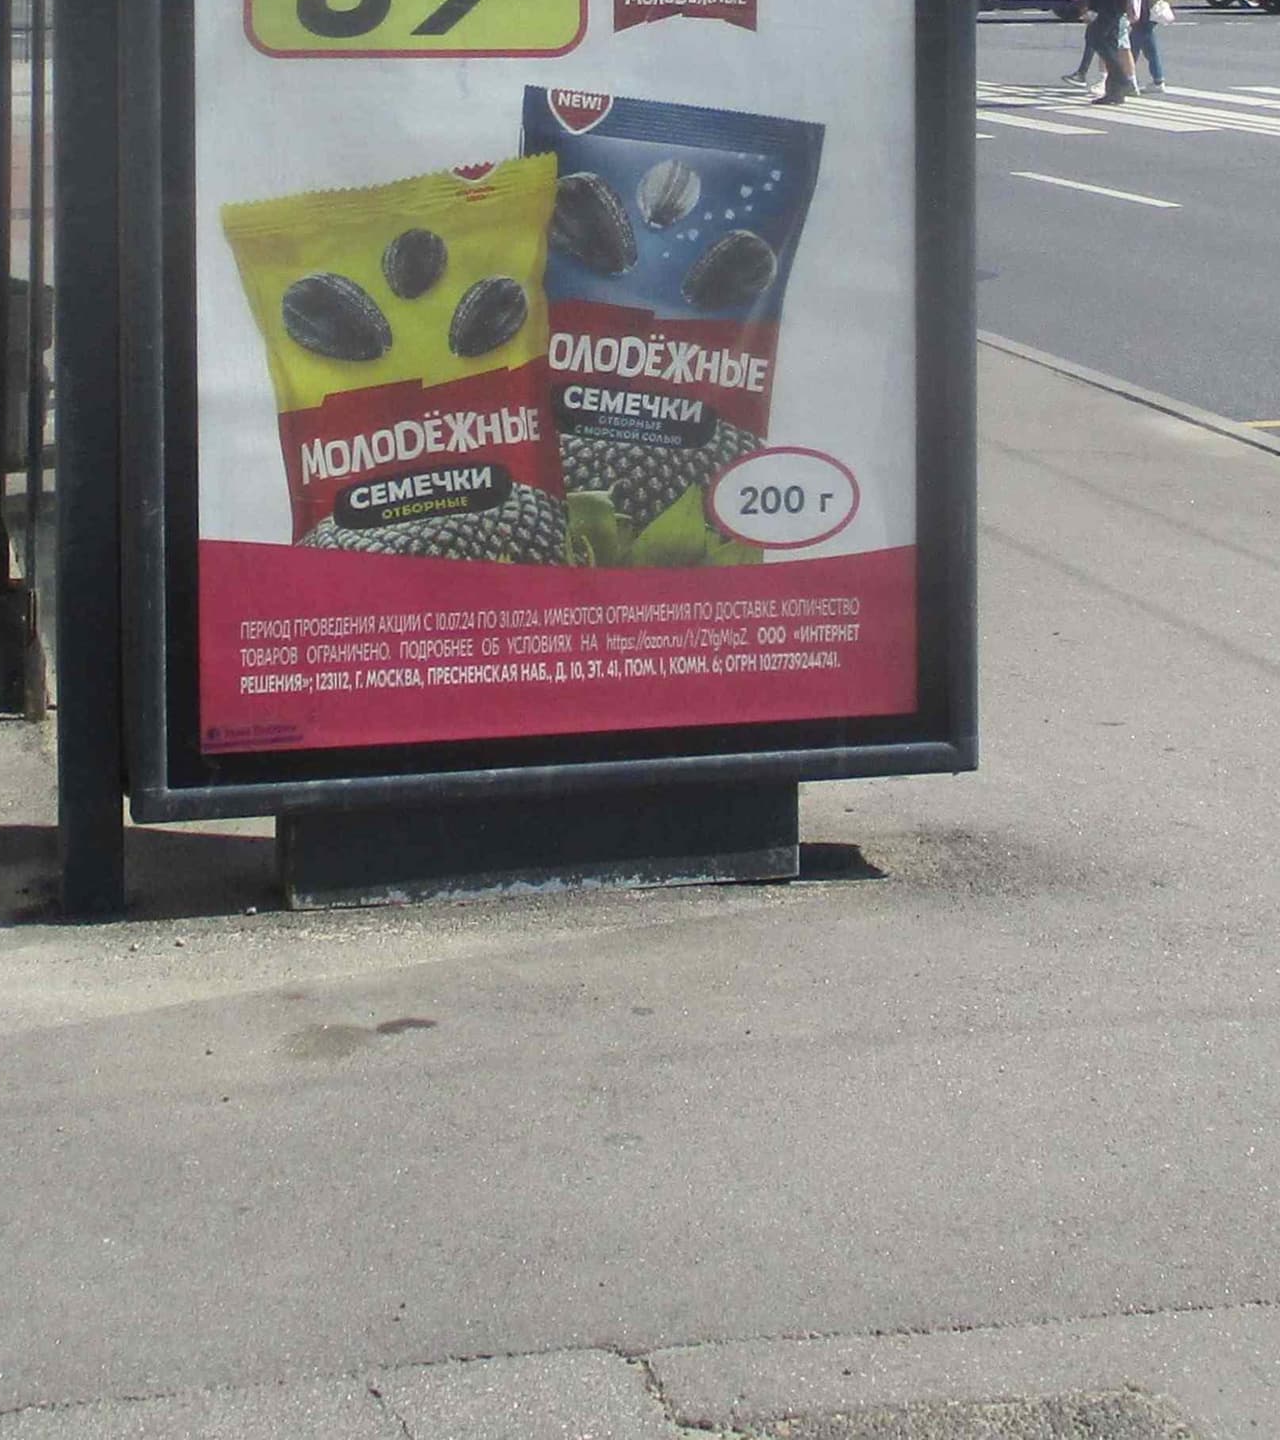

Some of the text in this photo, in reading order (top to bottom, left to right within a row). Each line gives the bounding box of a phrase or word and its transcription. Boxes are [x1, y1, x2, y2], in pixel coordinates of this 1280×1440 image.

[557, 91, 603, 111] NEW!
[563, 385, 703, 423] СЕМЕЧКИ
[584, 425, 640, 442] МОРСКОЙ
[642, 432, 683, 446] СОЛЬЮ
[598, 415, 663, 431] ОТБОРНЫЕ
[349, 466, 493, 510] СЕМЕЧКИ
[739, 485, 835, 515] 200 г
[381, 495, 469, 520] ОТБОРНЫЕ
[240, 620, 291, 640] ПЕРИОД
[294, 616, 376, 638] ПРОВЕДЕНИЯ
[377, 613, 421, 635] АКЦИИ
[423, 613, 433, 631] С
[435, 612, 475, 631] 10.07.24
[477, 611, 498, 629] ПО
[543, 606, 603, 626] ИМЕЮТСЯ
[605, 602, 691, 624] ОГРАНИЧЕНИЯ
[693, 601, 713, 620] ПО
[781, 596, 861, 617] КОЛИЧЕСТВО
[240, 646, 298, 667] ТОВАРОВ
[306, 641, 392, 665] ОГРАНИЧЕНО.
[399, 637, 473, 662] ПОДРОБНЕЕ
[481, 637, 500, 657] ОБ
[507, 633, 572, 655] УСЛОВИЯХ
[580, 632, 598, 651] НА
[757, 626, 786, 645] ООО
[793, 623, 861, 643] «ИНТЕРНЕТ
[240, 673, 313, 695] РЕШЕНИЯ»;
[316, 671, 352, 691] 123112,
[355, 670, 364, 689] Г.
[366, 668, 424, 689] МОСКВА,
[427, 663, 518, 686] ПРЕСНЕНСКАЯ
[520, 661, 553, 683] НАБ.,
[570, 661, 586, 681] 10,
[587, 660, 605, 680] ЭТ.
[624, 658, 657, 678] ПОМ.
[669, 655, 710, 675] КОМН.
[725, 653, 758, 673] ОГРН
